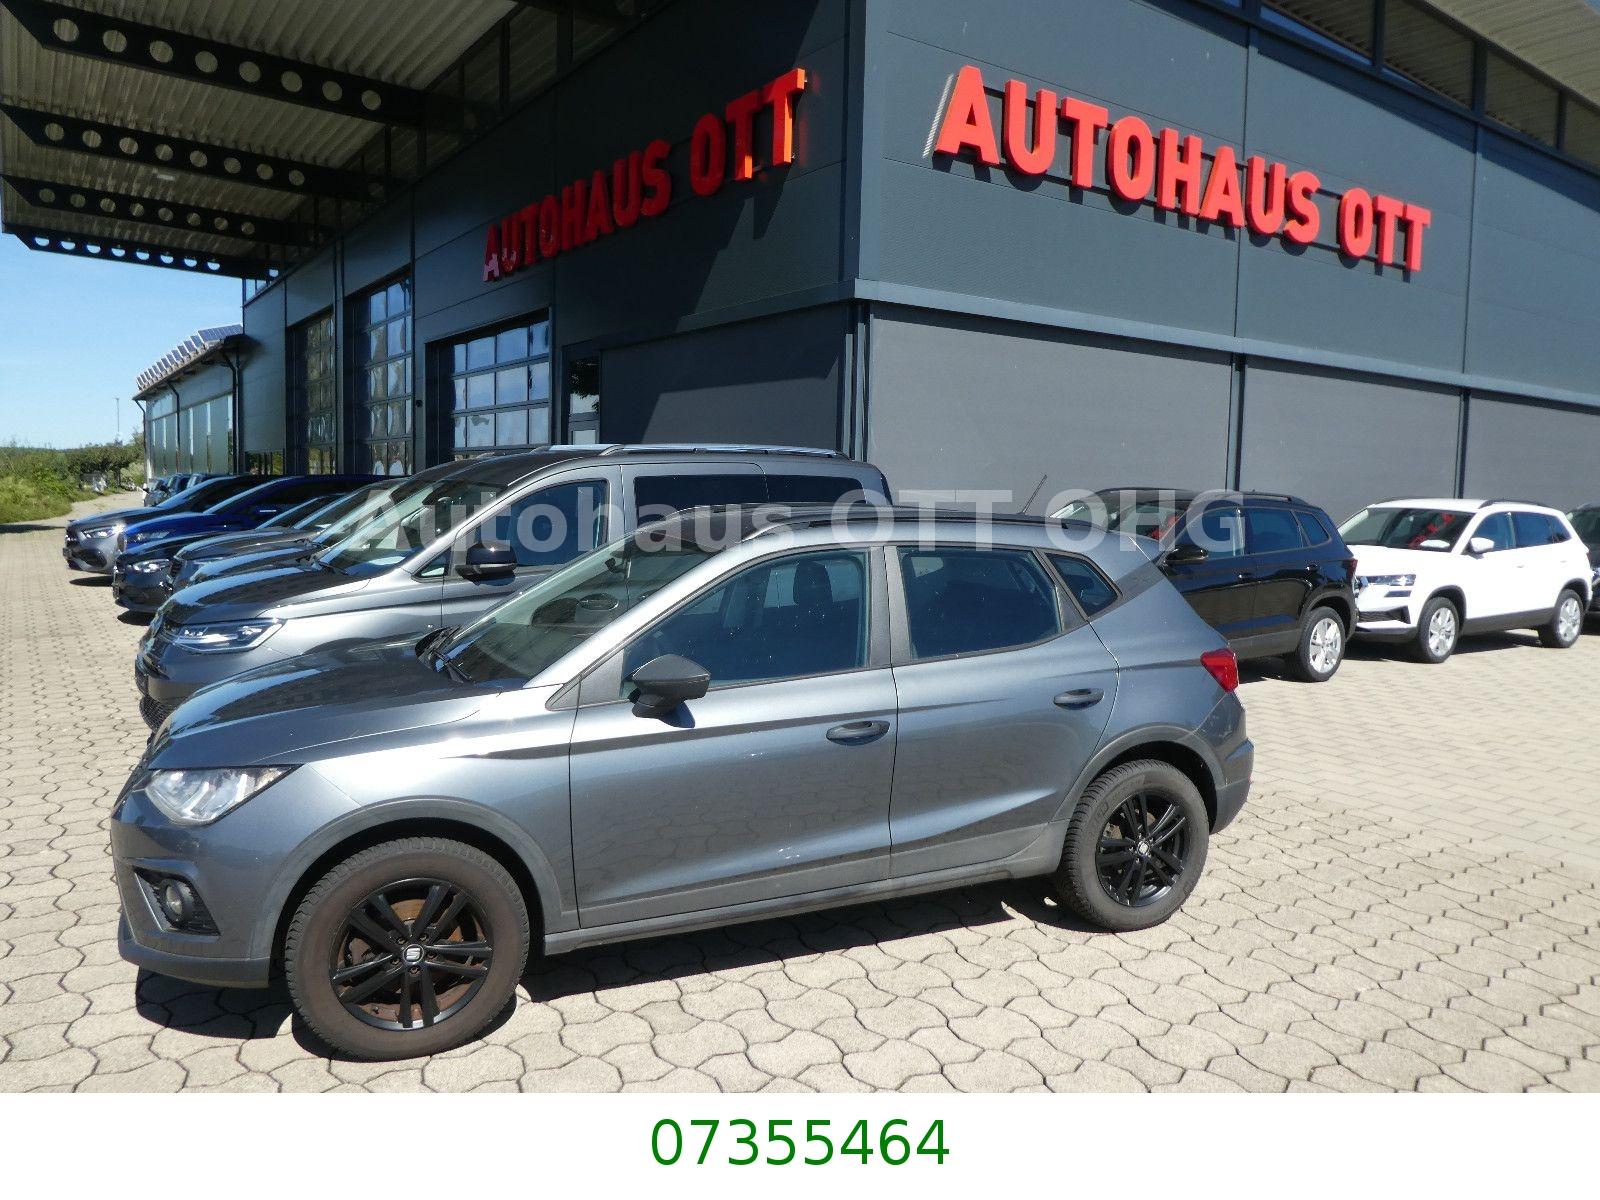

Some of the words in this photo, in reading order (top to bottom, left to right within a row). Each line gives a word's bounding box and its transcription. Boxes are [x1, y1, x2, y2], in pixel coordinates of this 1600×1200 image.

[482, 139, 671, 283] AUTOHAUS
[690, 68, 806, 196] OTT
[935, 66, 1320, 245] AUTOHAUS
[1338, 187, 1431, 271] OTT
